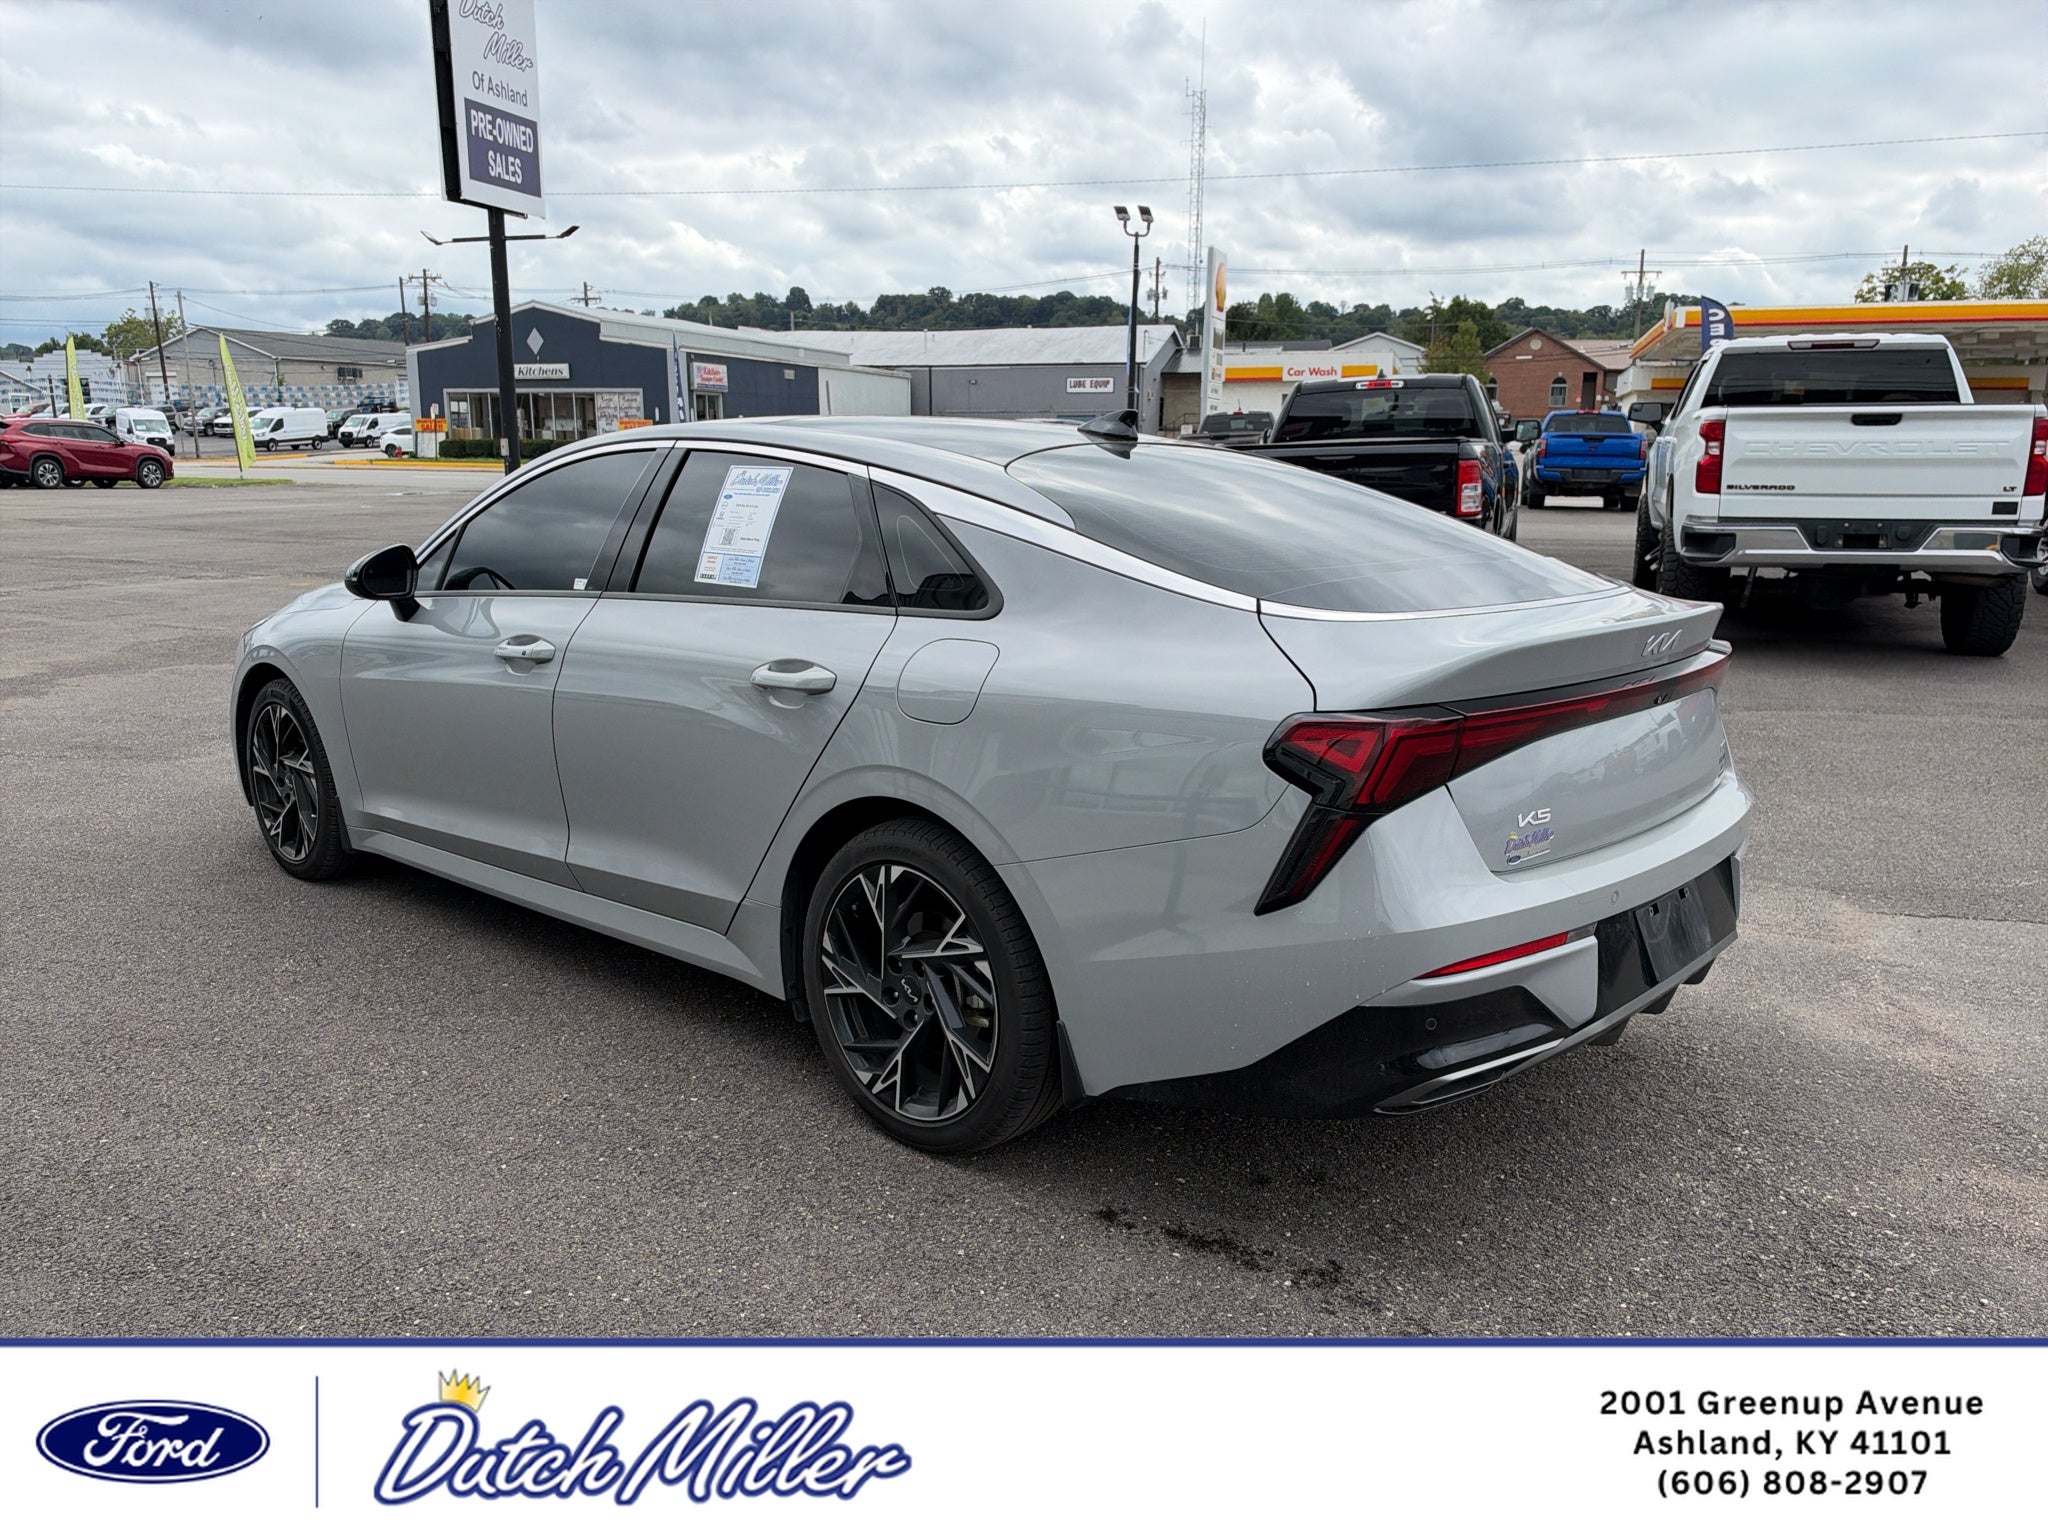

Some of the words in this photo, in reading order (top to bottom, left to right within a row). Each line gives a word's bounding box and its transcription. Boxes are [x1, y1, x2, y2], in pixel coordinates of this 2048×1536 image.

[459, 0, 504, 30] Dutch
[483, 31, 534, 72] Miller
[472, 70, 485, 91] Of
[487, 77, 528, 108] Ashland
[470, 108, 534, 153] PRE-OWNED
[487, 150, 523, 184] SALES
[518, 366, 564, 377] Kitchens
[1287, 367, 1305, 377] Car
[1308, 366, 1337, 376] Wash
[1069, 379, 1087, 389] LUBE
[1090, 379, 1111, 390] EQUIP
[1744, 441, 2010, 456] CHEVROLET
[1517, 808, 1551, 828] K5
